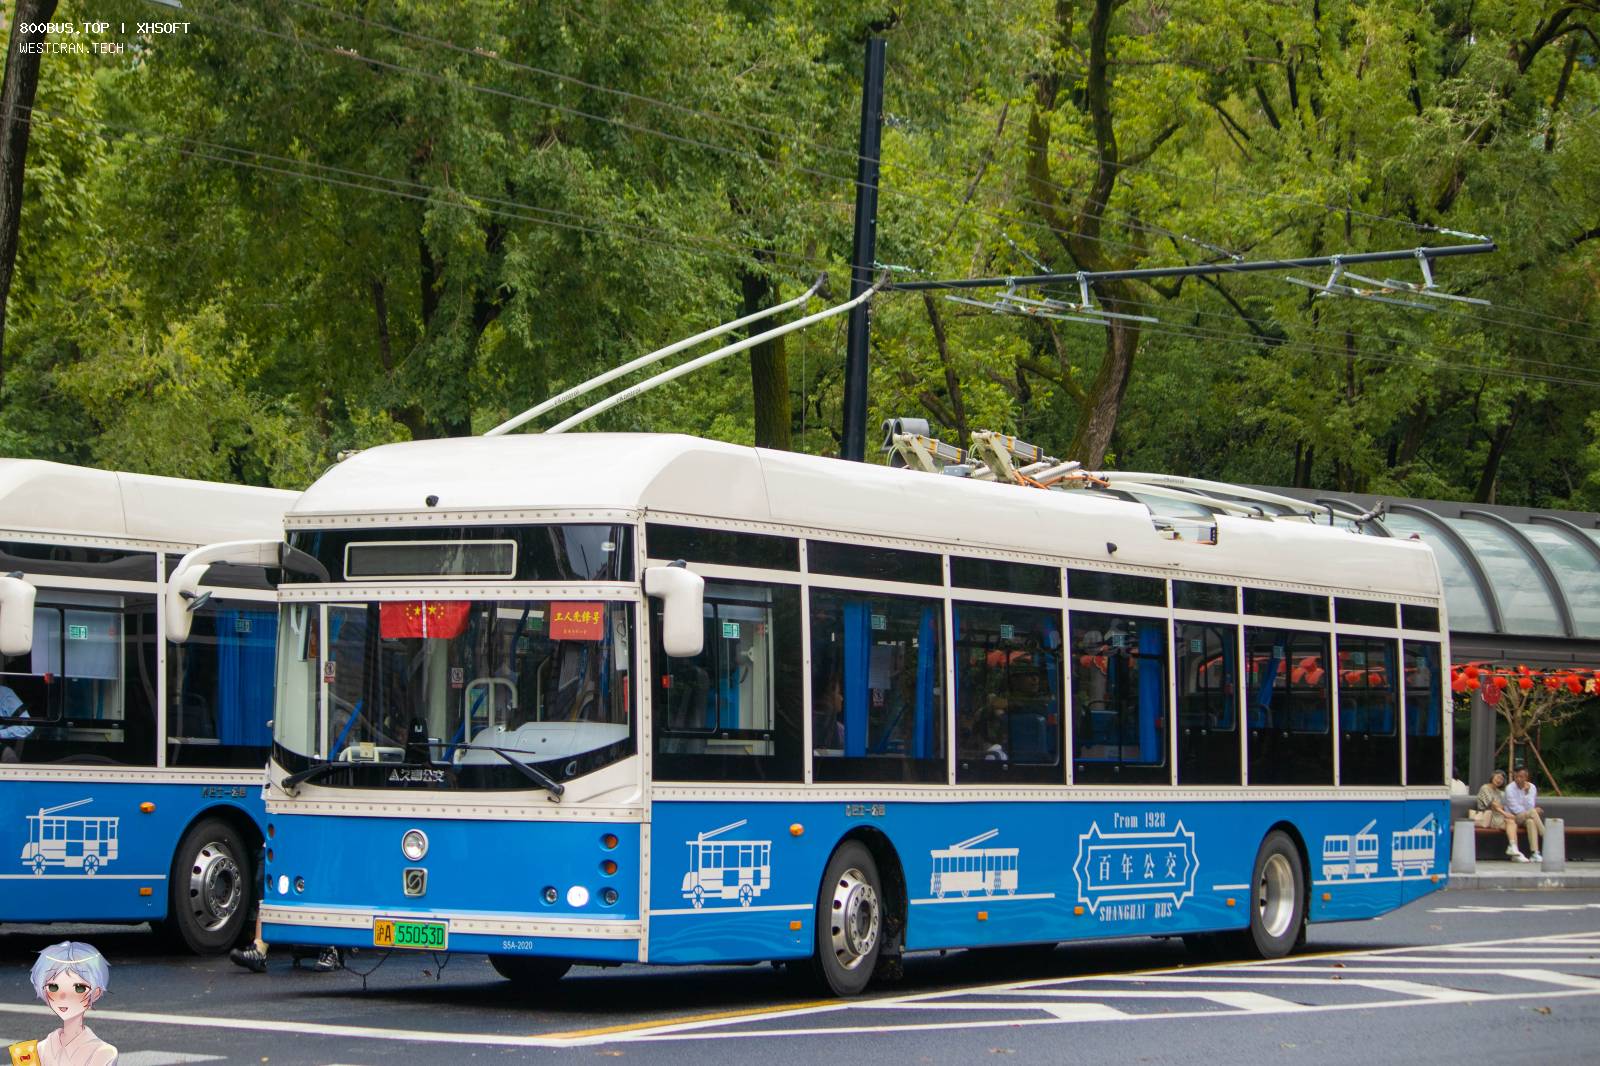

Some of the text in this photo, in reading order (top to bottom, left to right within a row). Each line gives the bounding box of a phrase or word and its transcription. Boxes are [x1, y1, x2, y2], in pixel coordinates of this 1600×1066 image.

[554, 609, 600, 625] 工人先锋号
[1114, 811, 1166, 828] From 1928
[1099, 851, 1177, 881] 百年公交
[1100, 902, 1172, 922] SHANGHAI BUS
[503, 940, 533, 950] S5A-2020
